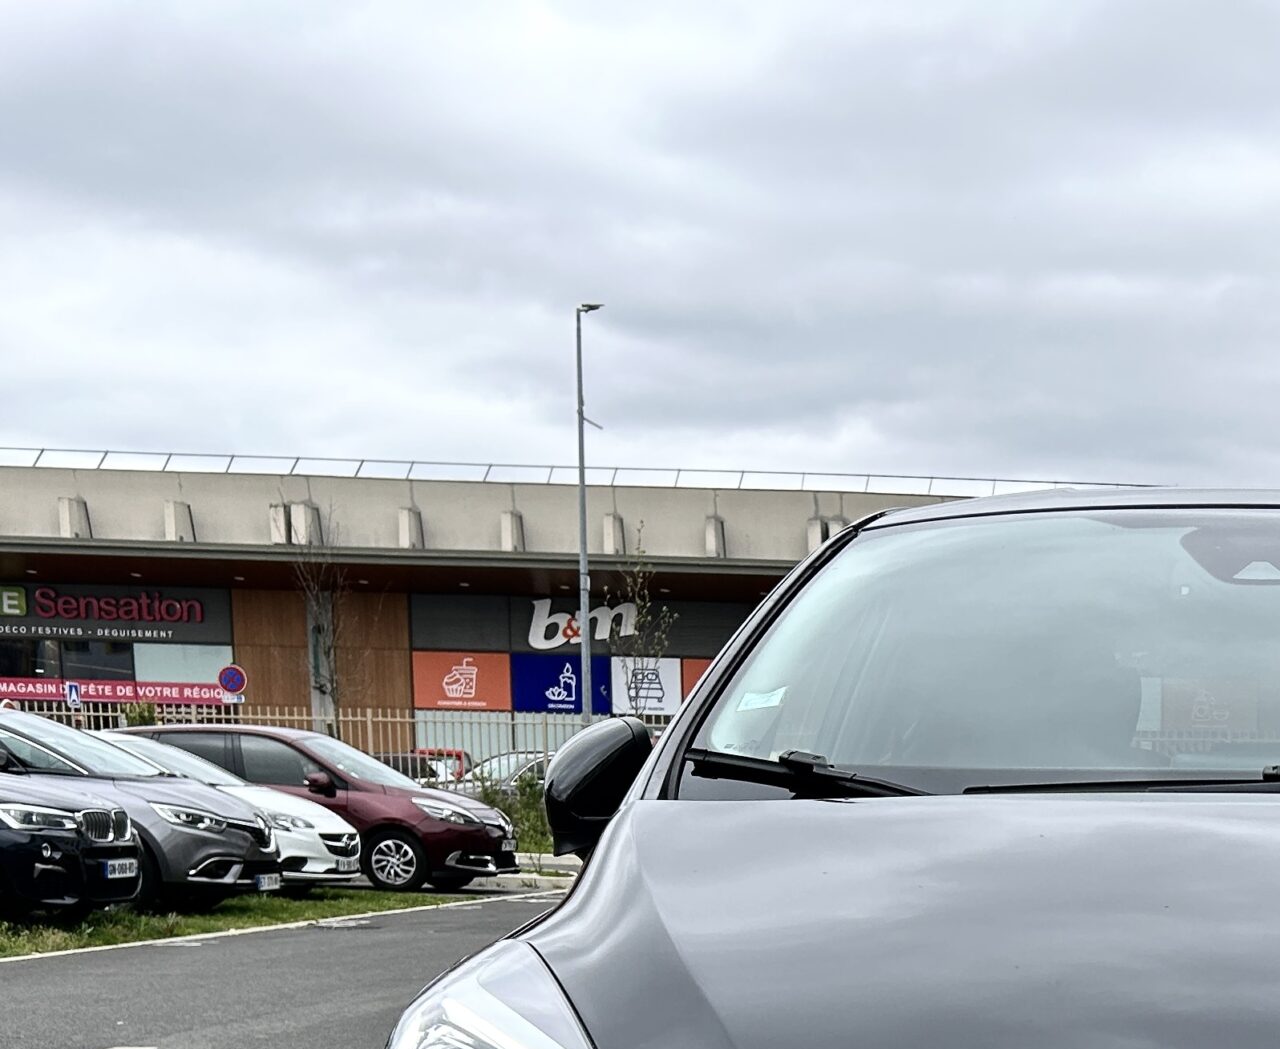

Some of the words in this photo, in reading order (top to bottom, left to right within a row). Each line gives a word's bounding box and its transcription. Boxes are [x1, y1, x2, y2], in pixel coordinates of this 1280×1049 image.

[34, 587, 204, 622] Sensation
[31, 626, 83, 636] FESTIVES
[527, 598, 639, 650] b&m
[0, 683, 56, 694] MAGASIN
[81, 683, 112, 695] FÊTE
[117, 686, 134, 696] DE
[137, 686, 179, 698] VOTRE
[184, 686, 223, 699] RÉGIO
